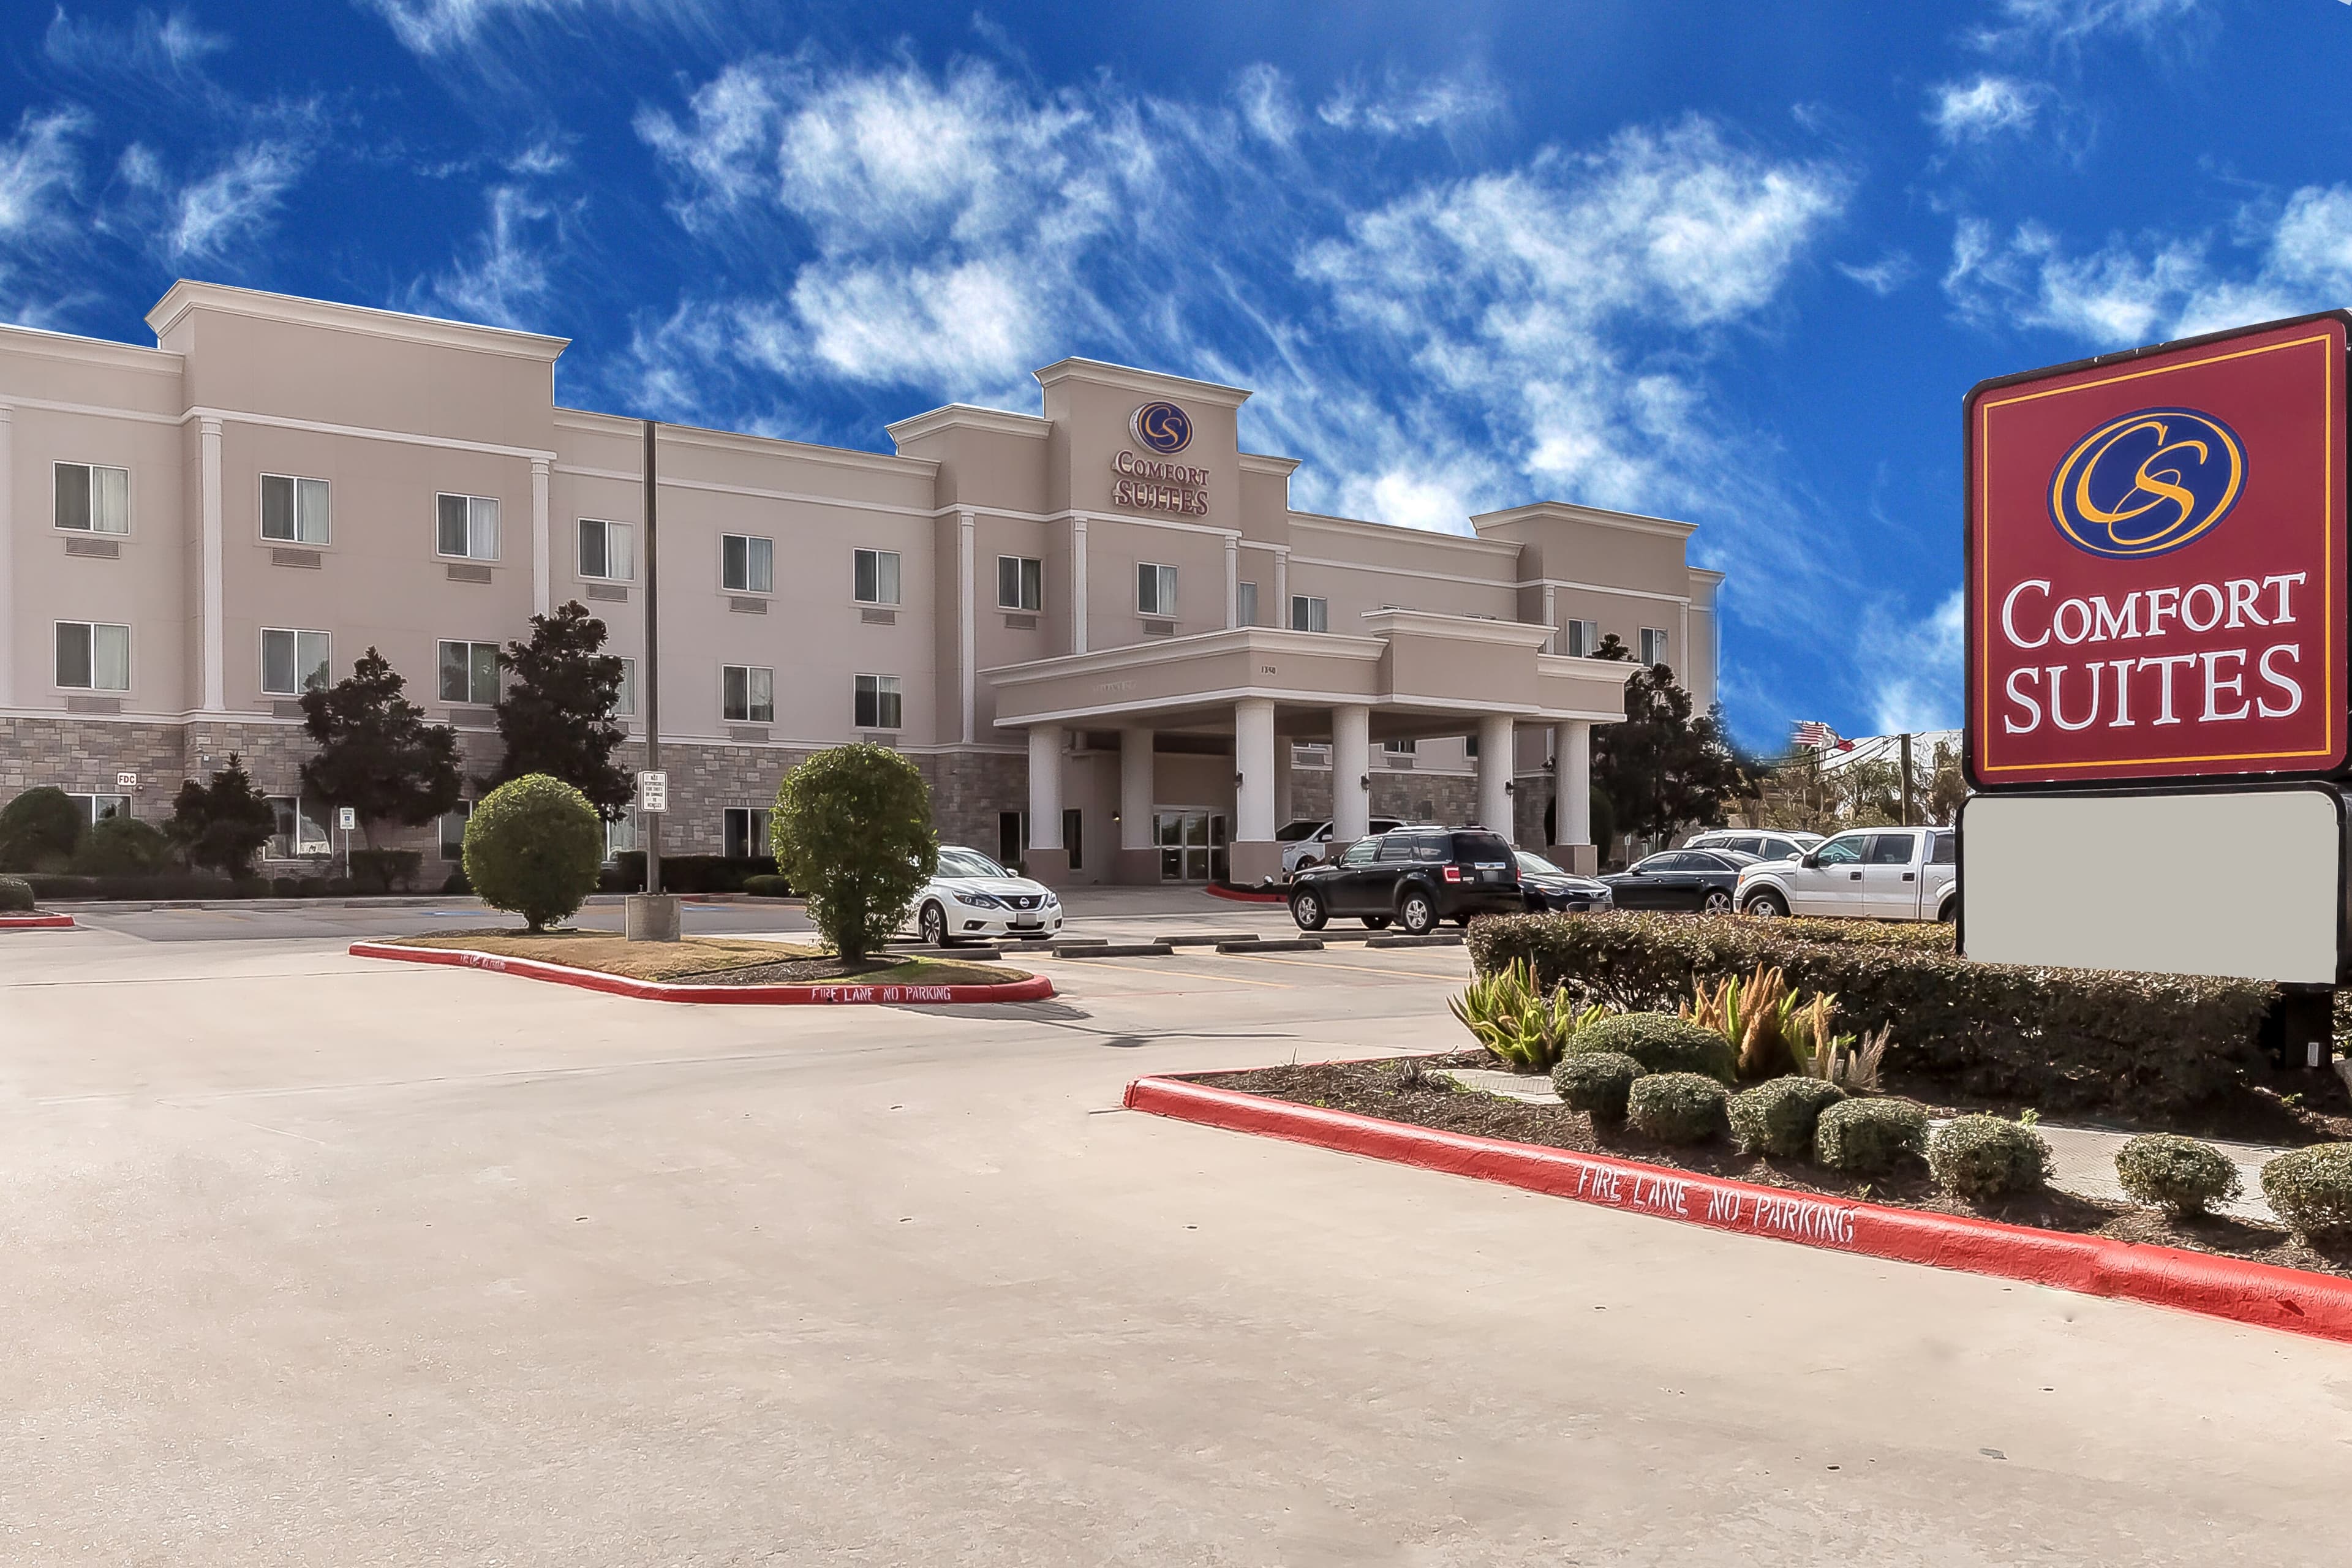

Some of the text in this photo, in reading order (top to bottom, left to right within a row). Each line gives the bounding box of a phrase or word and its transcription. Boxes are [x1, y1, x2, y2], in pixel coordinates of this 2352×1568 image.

[1116, 450, 1210, 486] COMFORT
[1117, 480, 1209, 516] SUITES
[2002, 571, 2307, 649] COMFORT
[2003, 643, 2302, 734] SUITES
[119, 775, 135, 783] FDC
[812, 987, 951, 1001] FIRE LANE NO PARKING
[1578, 1165, 1855, 1243] FIRE LANE NO PARKING
